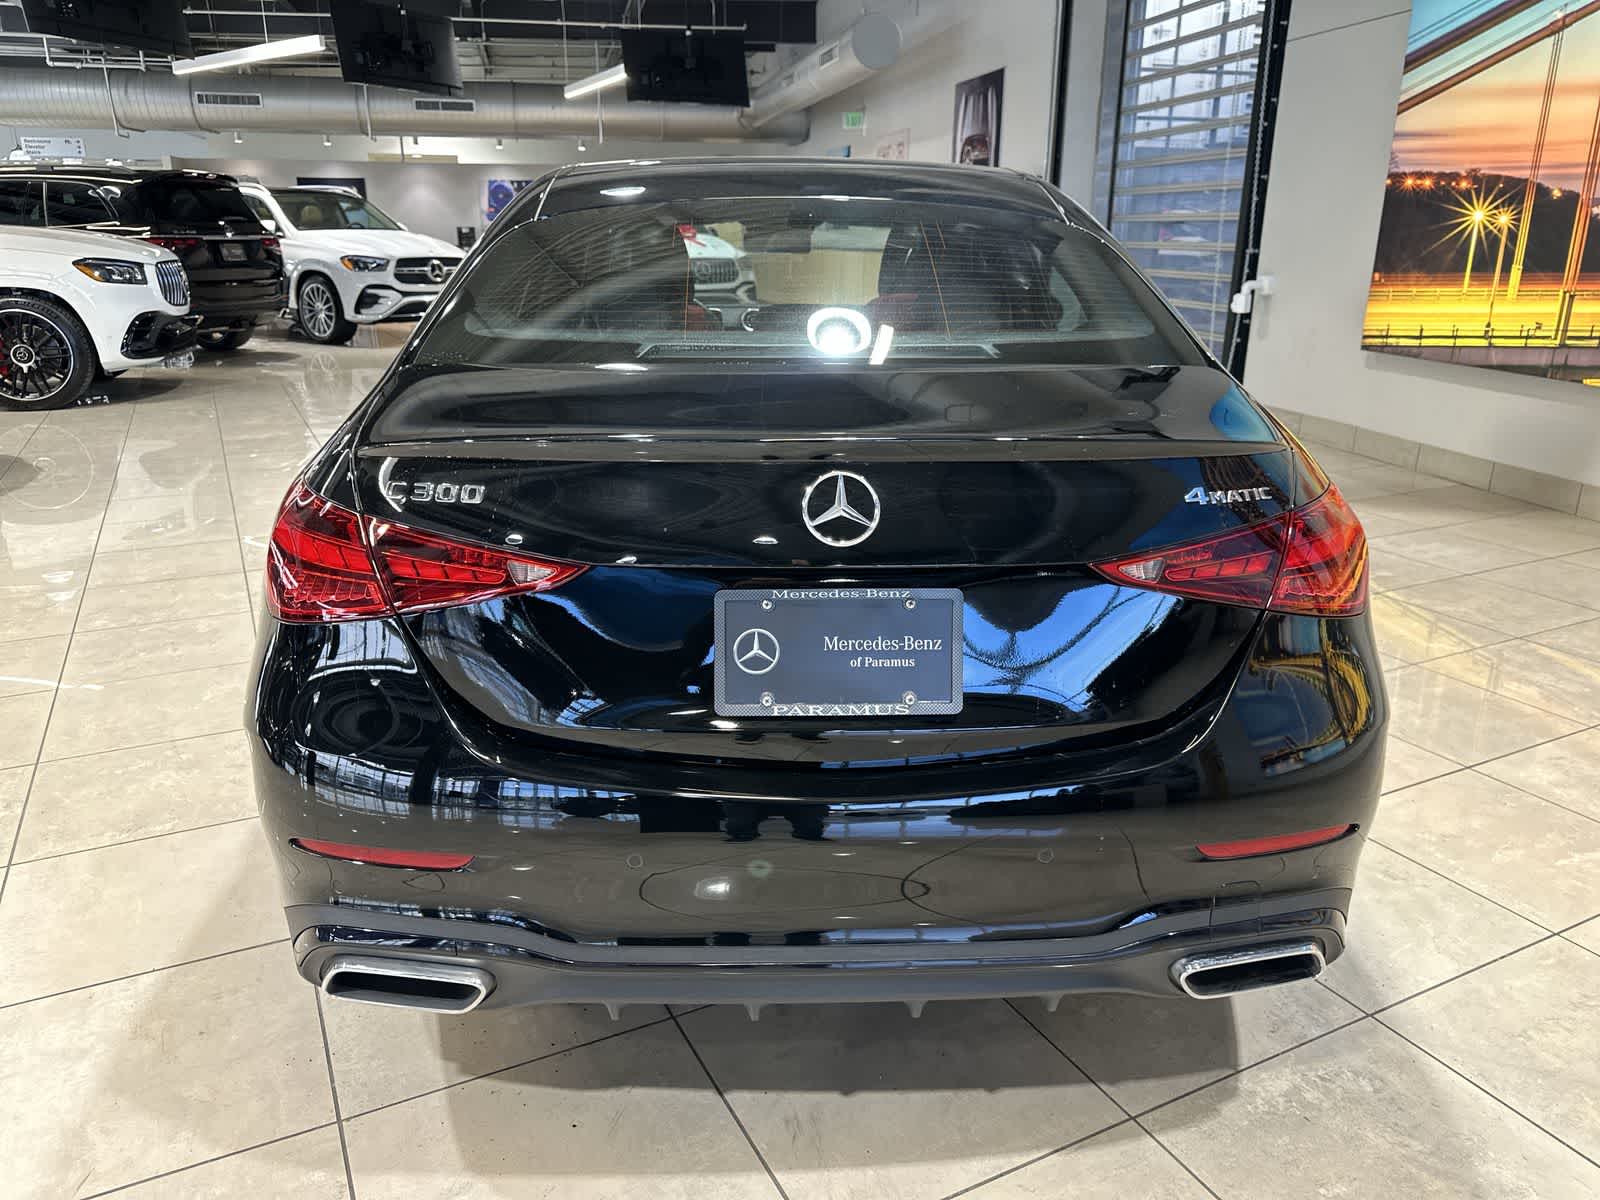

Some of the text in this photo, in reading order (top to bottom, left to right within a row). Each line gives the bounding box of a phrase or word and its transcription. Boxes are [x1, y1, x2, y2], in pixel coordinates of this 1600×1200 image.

[410, 481, 485, 504] 300
[1184, 486, 1273, 505] 4MATIC
[823, 635, 942, 651] Mercedes-Benz
[850, 656, 915, 667] of Paramus
[771, 703, 911, 716] PARAMUS
